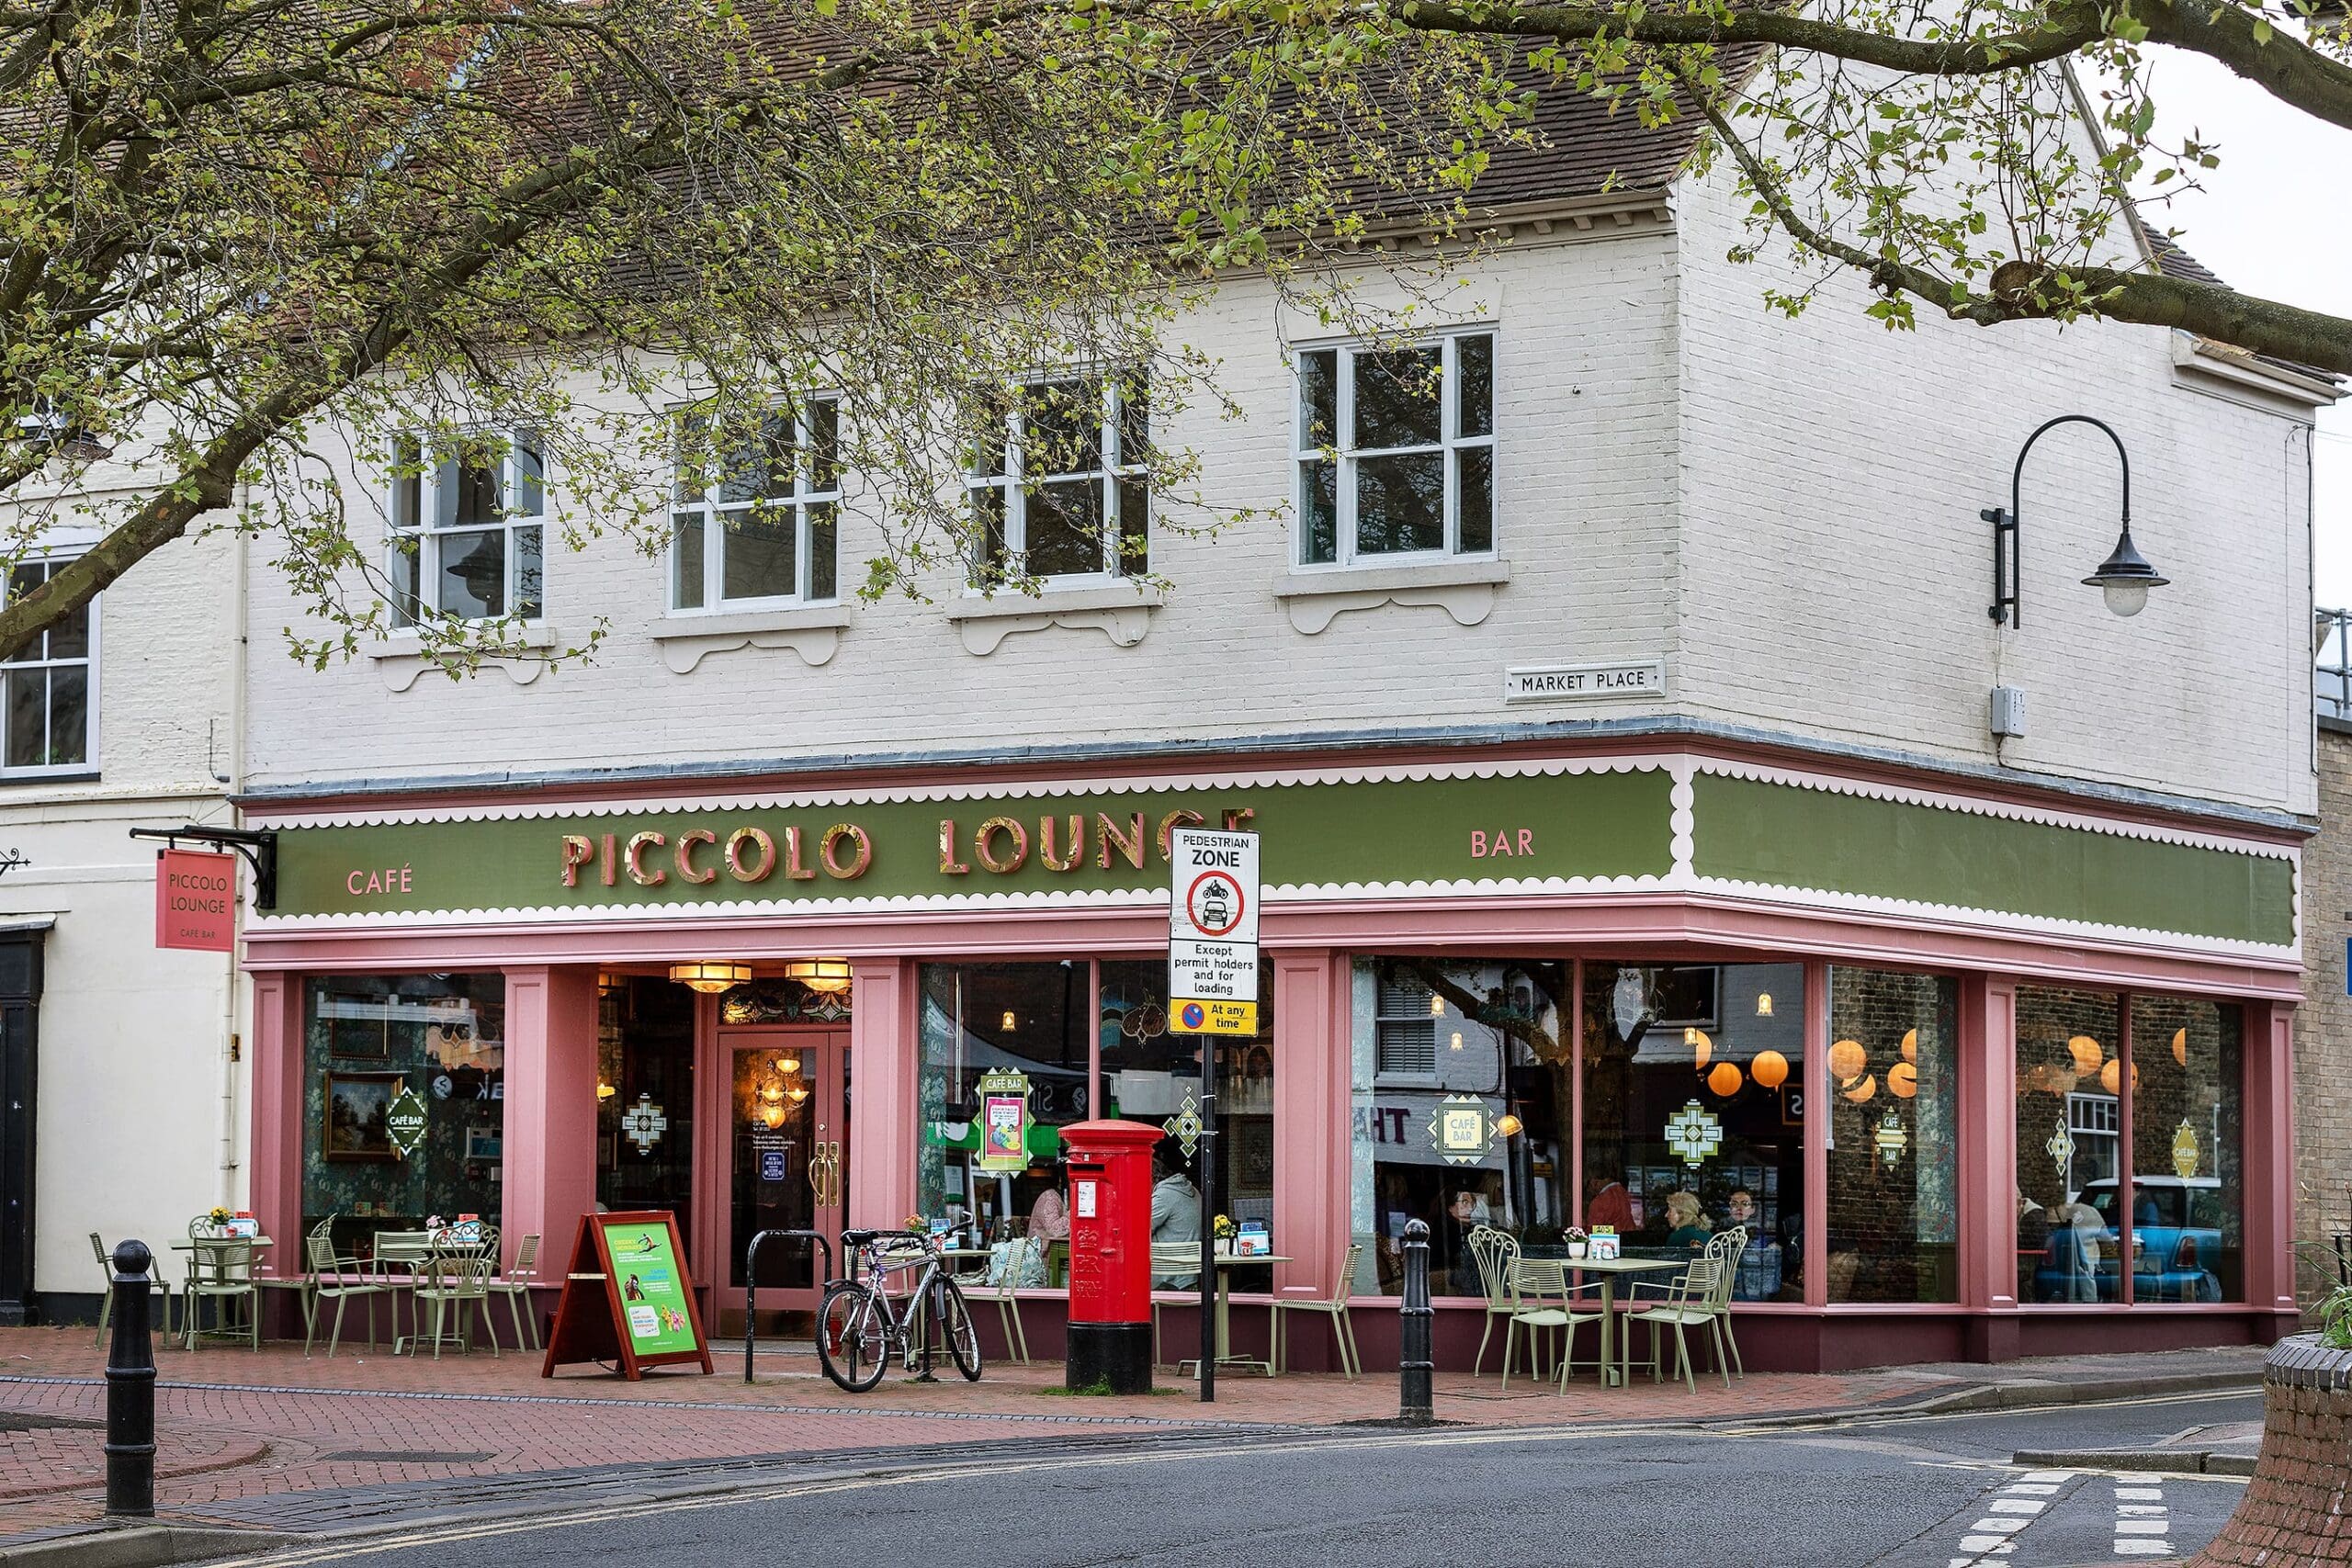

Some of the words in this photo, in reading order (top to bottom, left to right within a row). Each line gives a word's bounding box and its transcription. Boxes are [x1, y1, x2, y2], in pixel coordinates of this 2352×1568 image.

[1521, 675, 1585, 691] MARKET
[1597, 671, 1645, 687] PLACE
[1182, 835, 1250, 849] PEDESTRIAN
[1471, 829, 1535, 858] BAR
[560, 822, 871, 887] PICCOLO
[1192, 849, 1240, 867] ZONE
[169, 874, 227, 891] PICCOLO
[346, 862, 413, 896] CAFÉ
[171, 897, 225, 914] LOUNGE
[201, 930, 216, 939] BAR
[1195, 944, 1233, 956] Except
[1174, 957, 1210, 969] permit
[1215, 959, 1253, 970] holders
[1193, 970, 1214, 981] and
[1218, 970, 1235, 981] for
[1194, 983, 1234, 995] loading
[1211, 1004, 1224, 1014] At
[1227, 1006, 1246, 1017] any
[1216, 1017, 1240, 1028] time
[986, 1077, 1006, 1089] CAFÉ
[1007, 1078, 1023, 1089] BAR
[389, 1114, 408, 1125] CAFÉ
[408, 1116, 424, 1125] BAR
[1450, 1116, 1476, 1130] CAFÉ
[1453, 1131, 1473, 1142] BAR
